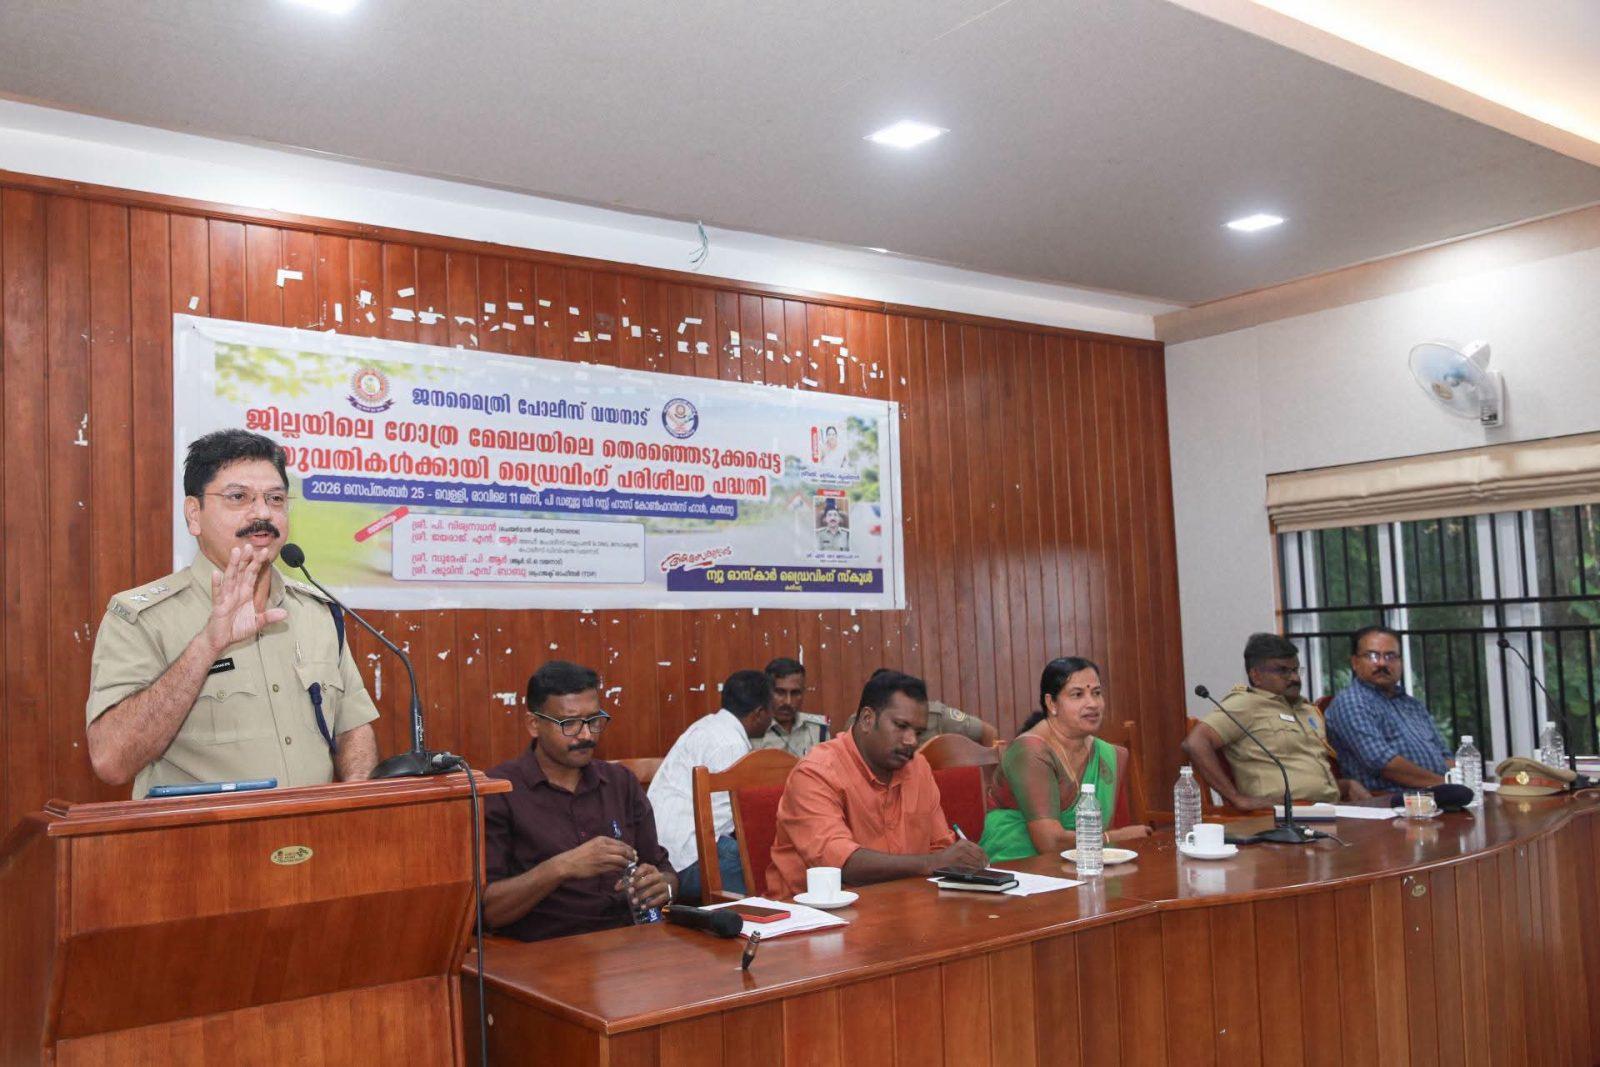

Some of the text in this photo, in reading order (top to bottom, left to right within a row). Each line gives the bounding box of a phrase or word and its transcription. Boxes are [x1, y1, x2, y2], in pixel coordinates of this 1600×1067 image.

[412, 388, 511, 415] ജനമൈത്രി
[518, 399, 587, 421] പോലീസ്
[591, 406, 651, 426] വയനാട്
[246, 406, 374, 439] ജില്ലയിലെ
[385, 421, 459, 449] ഗോത്ര
[469, 427, 593, 456] മേഖലയിലെ
[603, 439, 781, 474] തെരഞ്ഞെടുക്കപ്പെട്ട
[312, 482, 341, 495] 2026
[411, 487, 424, 499] 25
[435, 488, 468, 504] വെള്ളി,
[471, 489, 507, 503] രാവിലെ
[509, 492, 518, 504] 11
[520, 491, 542, 506] മണി,
[545, 495, 554, 506] പി
[499, 462, 613, 487] ഡ്രൈവിംഗ്
[617, 467, 705, 492] പരിശീലന
[712, 475, 767, 496] പദ്ധതി
[727, 568, 777, 582] ഓസ്കാർ
[780, 569, 836, 584] ഡ്രൈവിംഗ്
